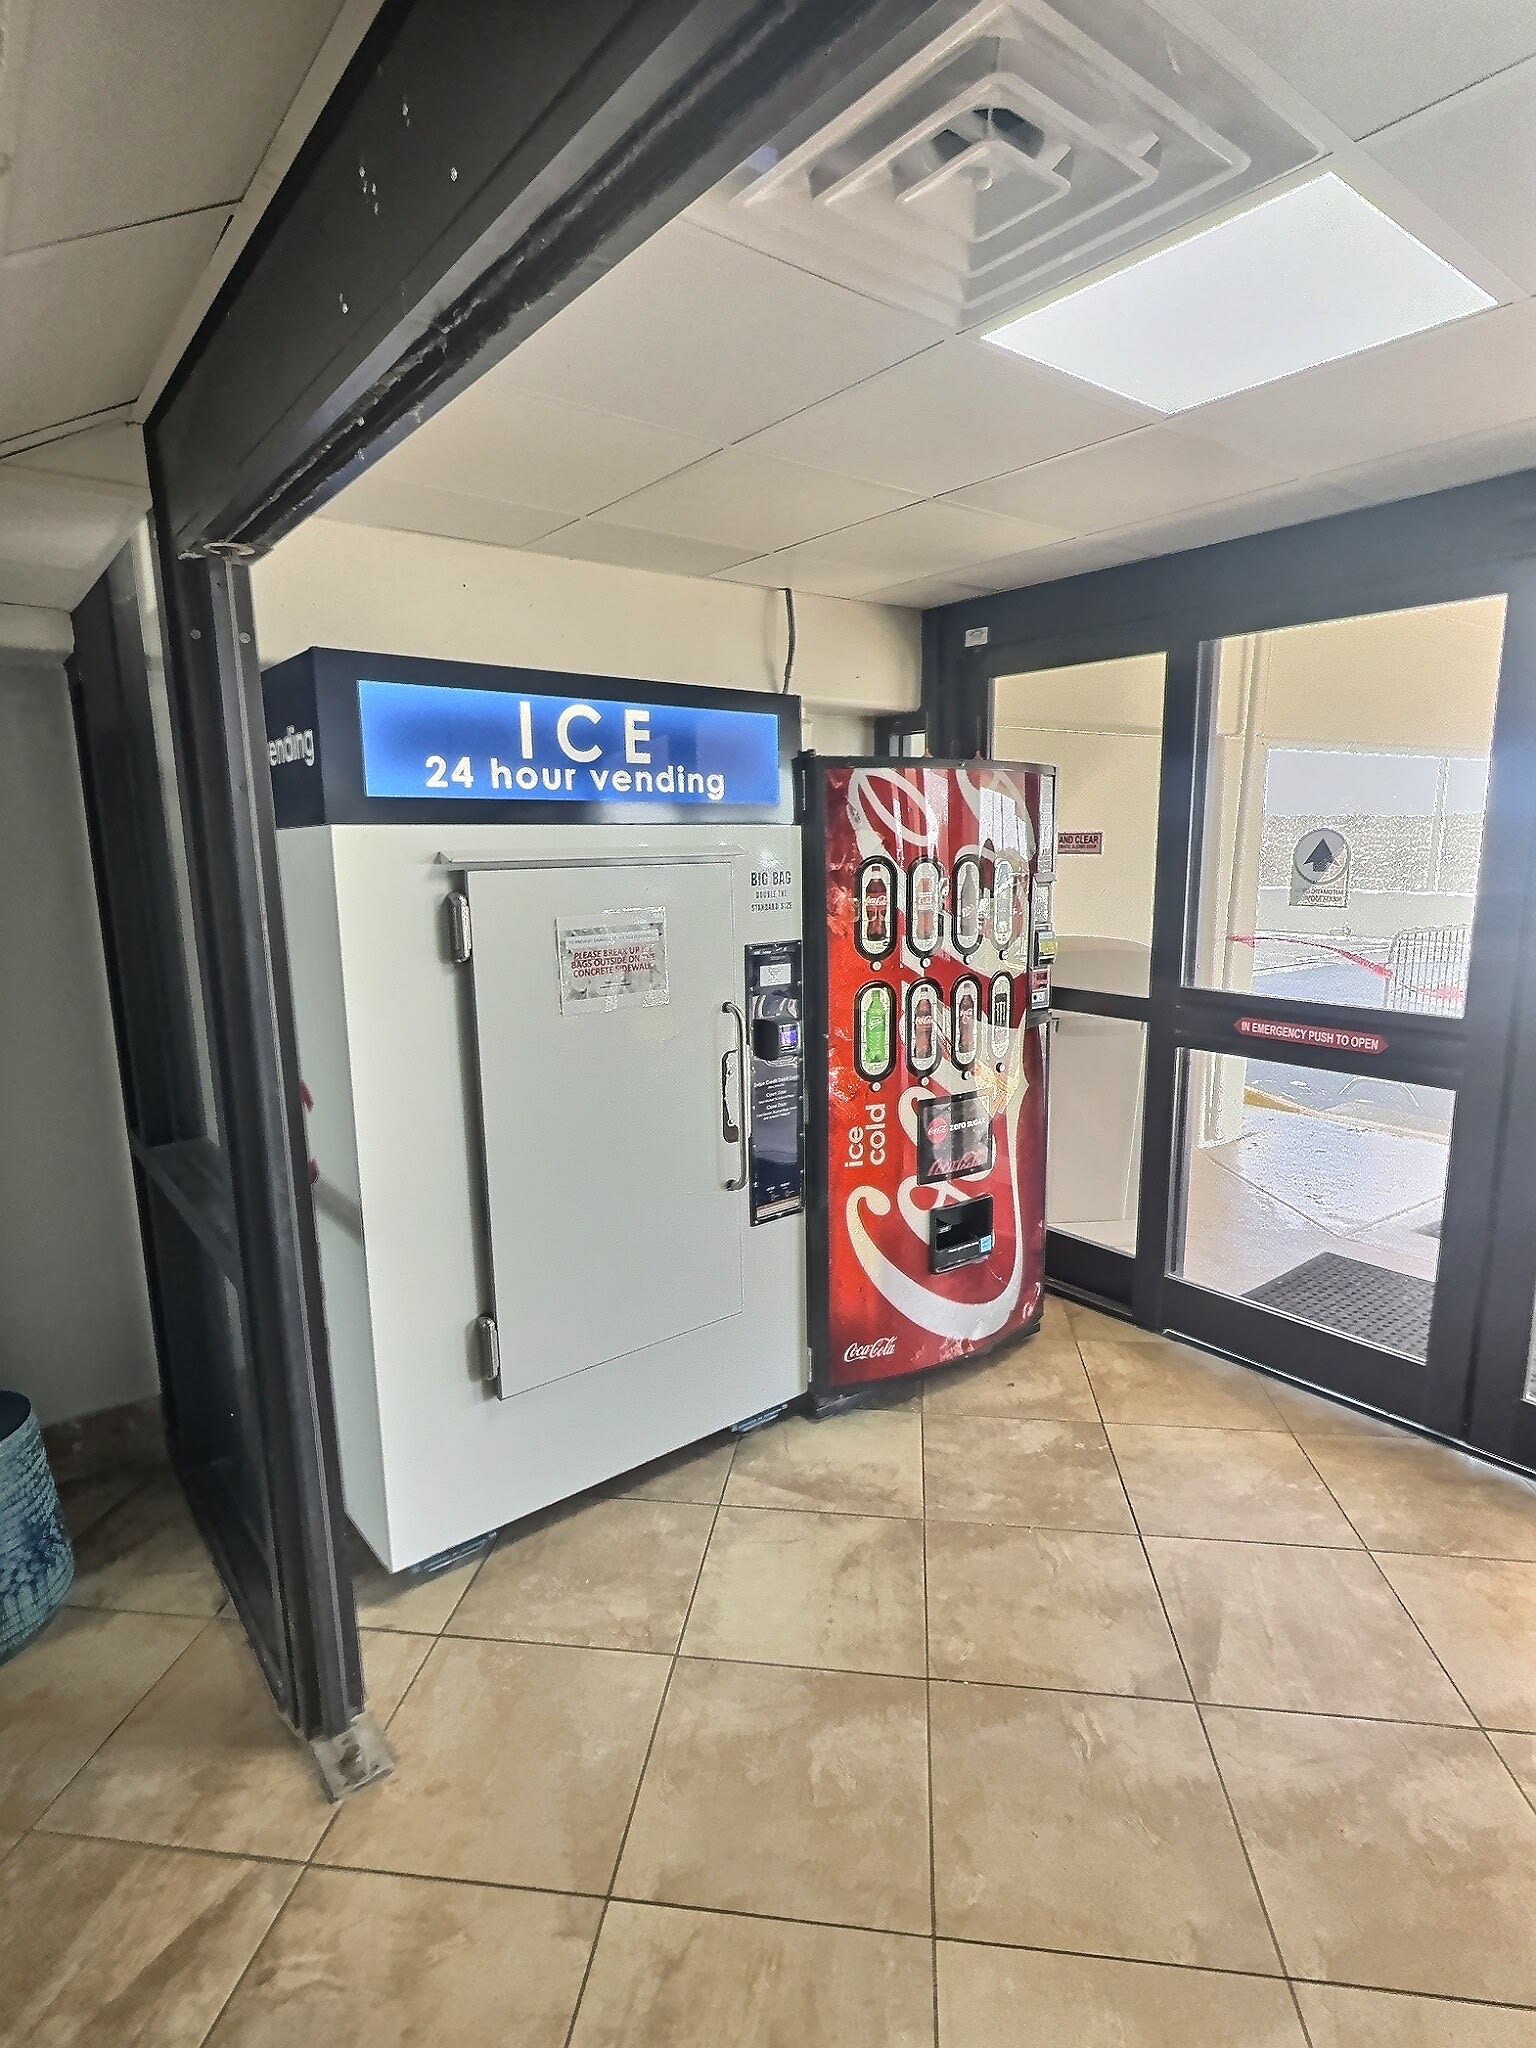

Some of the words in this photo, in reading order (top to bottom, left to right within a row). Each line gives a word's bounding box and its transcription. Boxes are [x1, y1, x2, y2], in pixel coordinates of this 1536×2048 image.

[268, 724, 315, 767] ending
[519, 701, 651, 763] ICE
[425, 755, 475, 788] 24
[491, 757, 577, 791] hour
[589, 765, 725, 800] vending
[1075, 836, 1098, 844] CLEAR
[751, 871, 769, 886] BIG
[773, 870, 791, 885] BAG
[571, 960, 593, 969] BAGS
[594, 957, 627, 966] OUTSIDE
[629, 955, 641, 963] ON
[573, 950, 601, 960] PLEASE
[603, 948, 628, 957] BREAK
[629, 946, 640, 955] UP
[573, 967, 614, 977] CONCRETE
[615, 962, 654, 973] SIDEWALK
[1241, 1021, 1250, 1031] IN
[1252, 1022, 1307, 1040] EMERGENCY
[1308, 1030, 1334, 1044] PUSH
[1336, 1034, 1348, 1046] TO
[1350, 1036, 1379, 1050] OPEN
[844, 1126, 864, 1168] ice
[865, 1103, 886, 1166] cold
[844, 1336, 897, 1362] Coca-Cola
